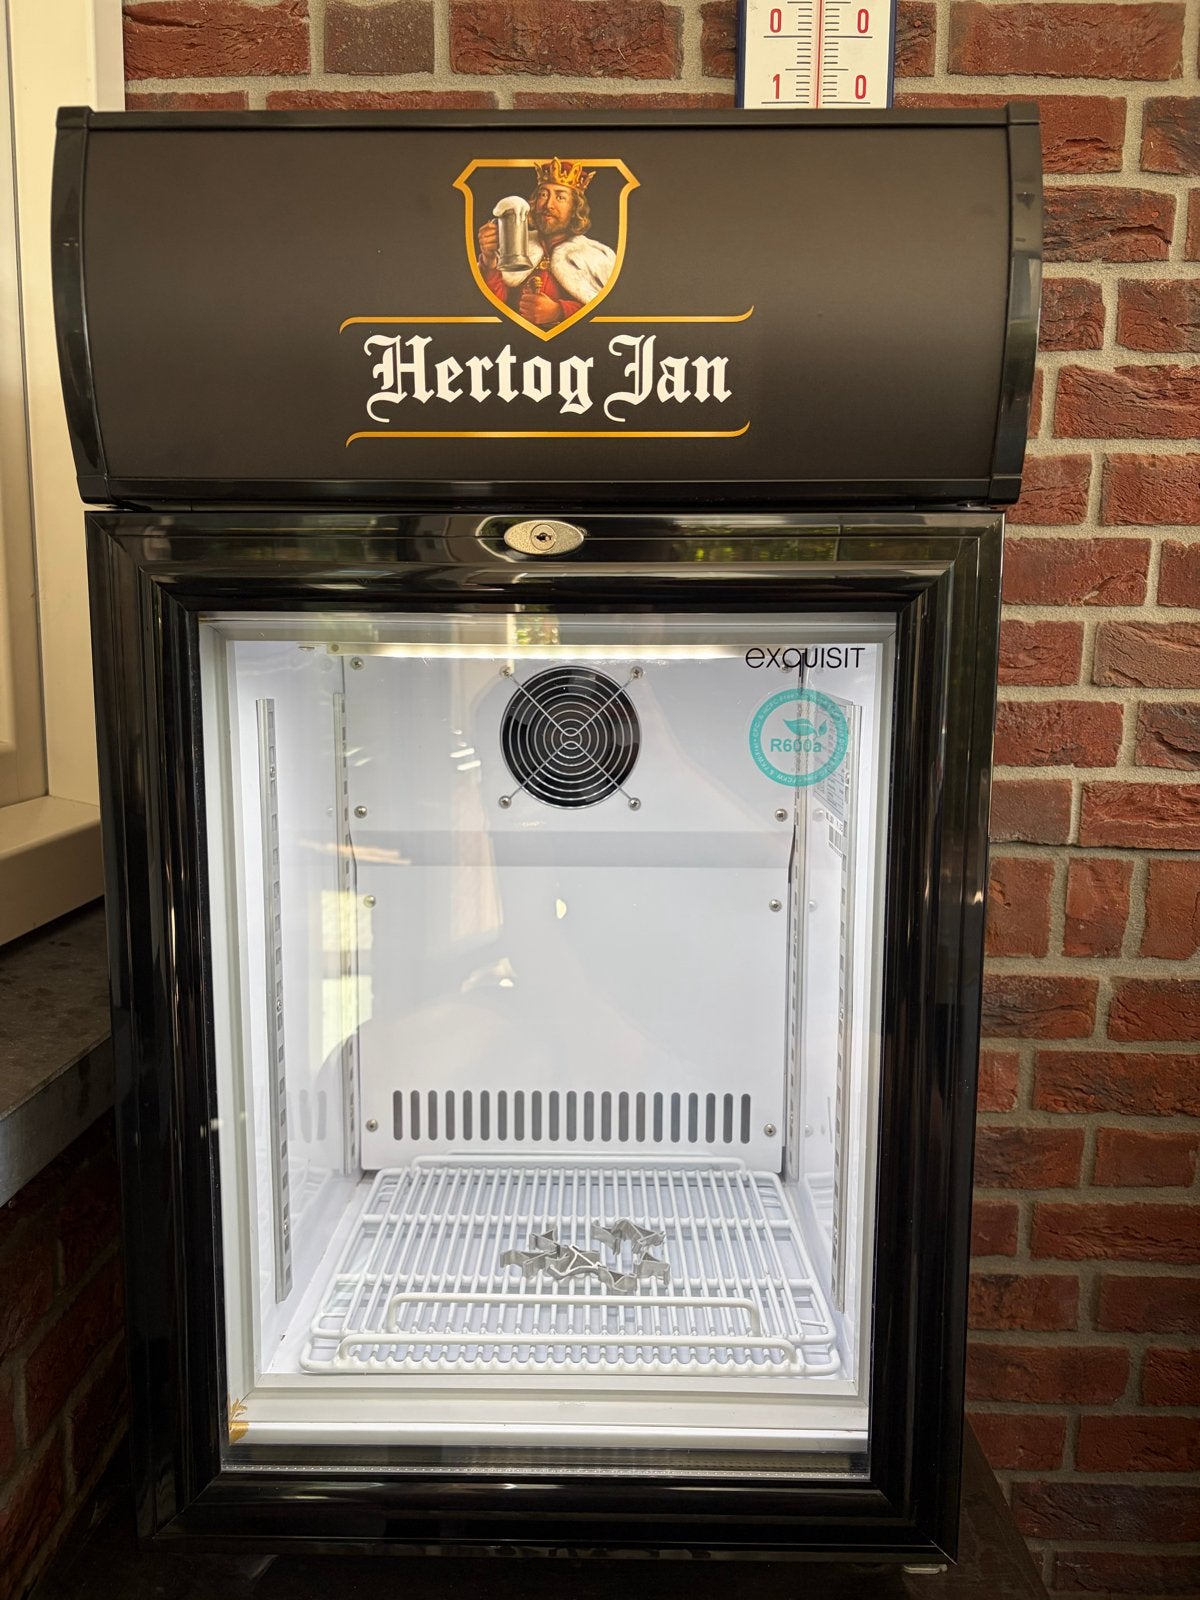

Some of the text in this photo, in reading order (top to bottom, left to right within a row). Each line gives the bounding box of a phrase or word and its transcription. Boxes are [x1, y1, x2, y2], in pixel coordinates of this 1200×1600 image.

[769, 8, 870, 34] 0 0
[772, 74, 867, 100] 1 0
[364, 334, 732, 423] Hertog Jan
[770, 738, 822, 752] R600a
